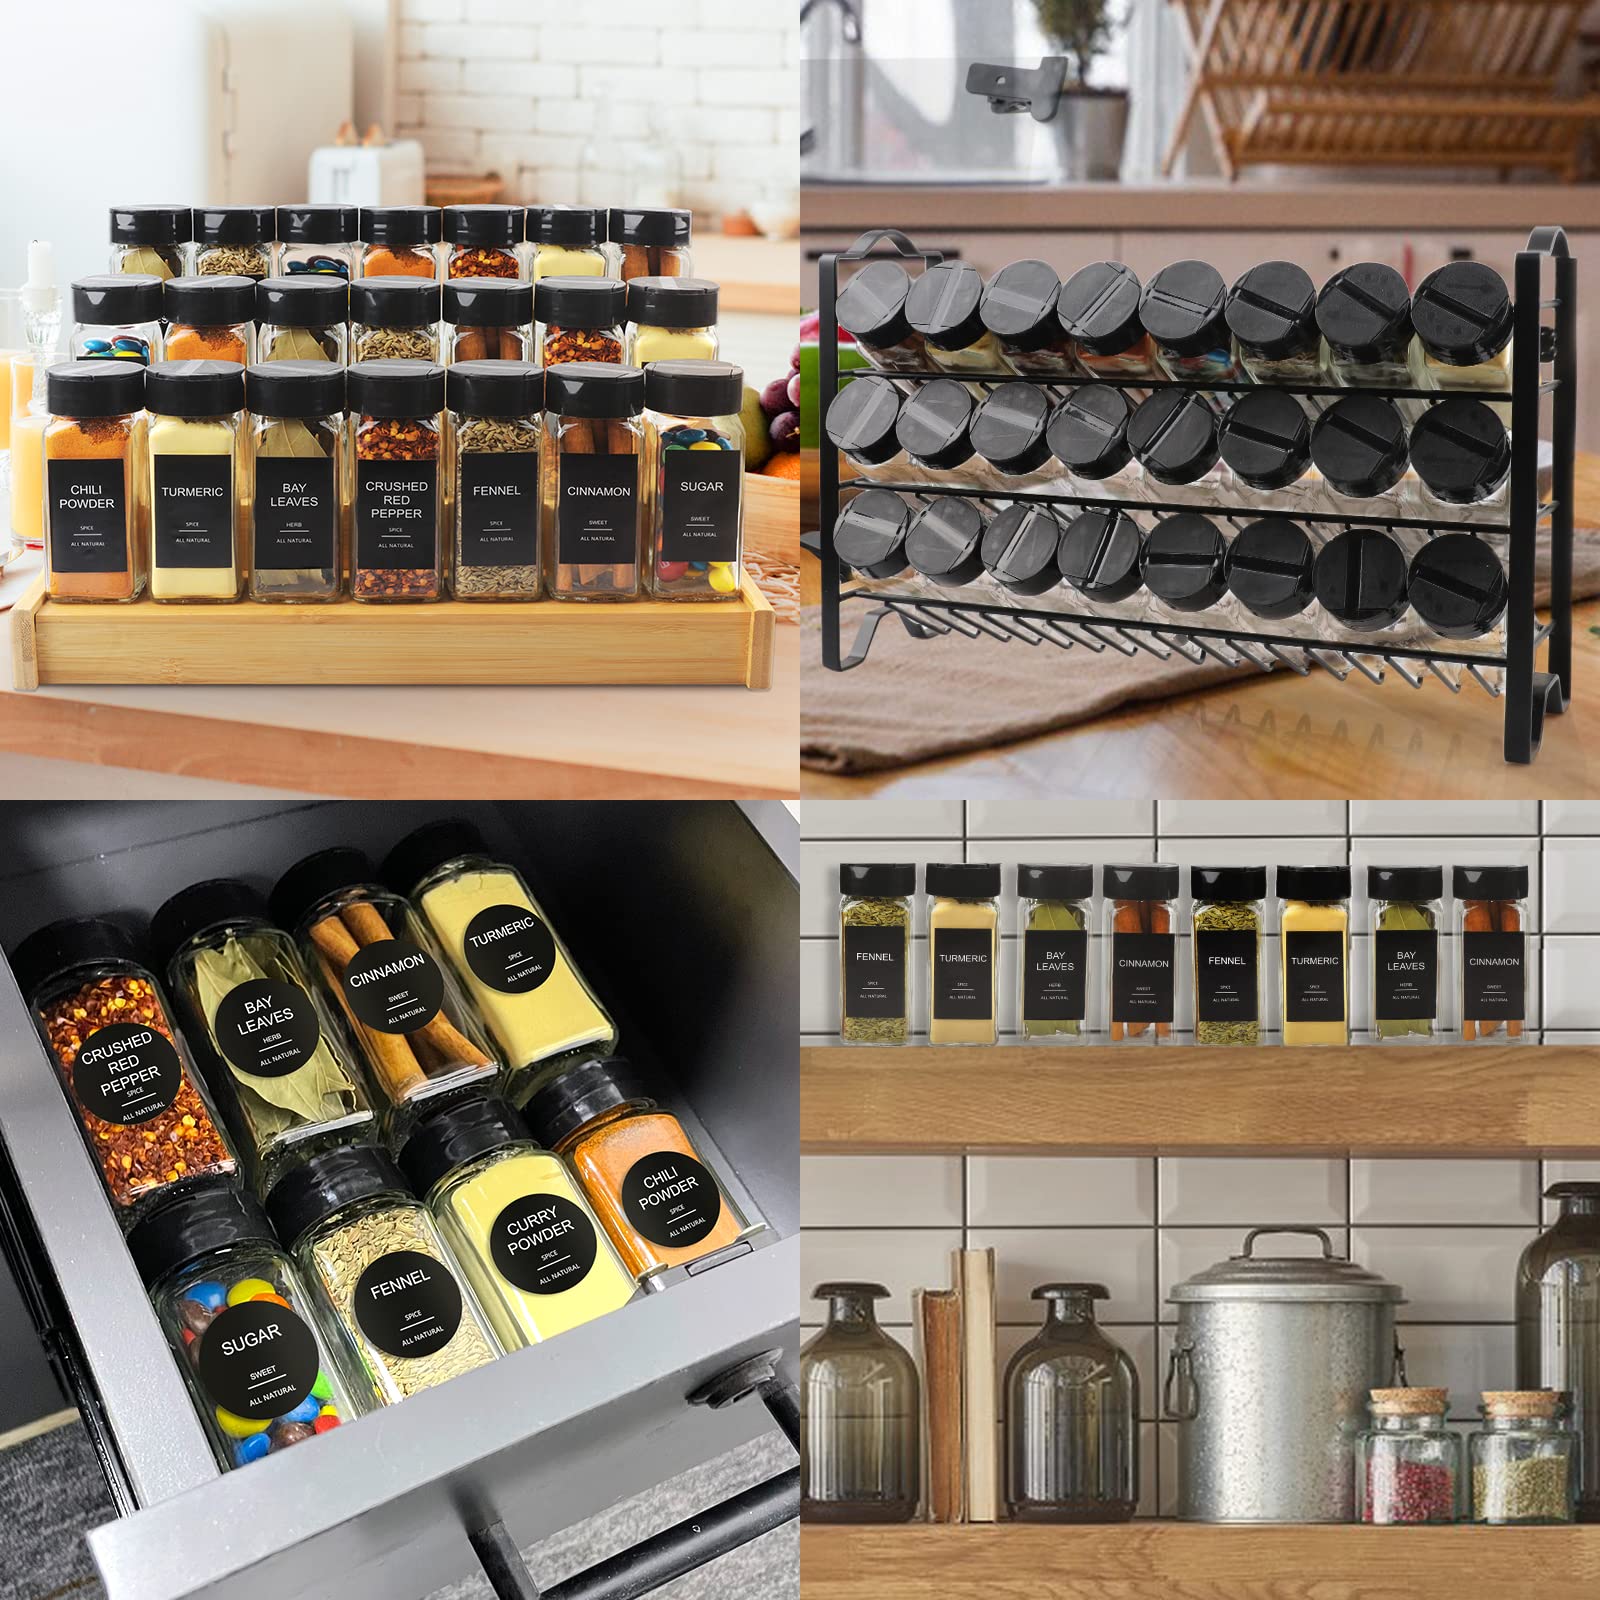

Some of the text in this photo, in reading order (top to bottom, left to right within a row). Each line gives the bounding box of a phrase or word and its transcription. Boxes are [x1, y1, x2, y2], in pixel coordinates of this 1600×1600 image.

[71, 485, 101, 495] CHILI
[162, 487, 223, 496] TURMERIC
[283, 484, 306, 492] BAY
[366, 482, 428, 491] CRUSHED
[474, 486, 520, 495] FENNEL
[568, 487, 630, 496] CINNAMON
[681, 482, 723, 491] SUGAR
[60, 499, 114, 508] POWDER
[271, 497, 318, 506] LEAVES
[384, 496, 410, 505] RED
[372, 509, 421, 518] PEPPER
[470, 917, 535, 948] TURMERIC
[508, 952, 523, 961] SPICE
[857, 953, 893, 961] FENNEL
[350, 954, 424, 988] CINNAMON
[507, 965, 542, 983] ALL NATURAL
[244, 996, 273, 1015] BAY
[388, 991, 409, 1003] SWEET
[237, 1007, 294, 1036] LEAVES
[388, 1006, 427, 1025] ALL NATURAL
[263, 1033, 281, 1044] HERB
[81, 1032, 153, 1066] CRUSHED
[260, 1048, 301, 1066] ALL NATURAL
[109, 1055, 140, 1074] RED
[100, 1066, 162, 1096] PEPPER
[127, 1087, 144, 1098] SPICE
[122, 1101, 165, 1122] ALL NATURAL
[643, 1166, 678, 1190] CHILI
[639, 1177, 699, 1211] POWDER
[670, 1205, 685, 1216] SPICE
[507, 1206, 558, 1237] CURRY
[669, 1217, 706, 1238] ALL NATURAL
[508, 1220, 575, 1256] POWDER
[541, 1250, 558, 1262] SPICE
[540, 1264, 580, 1286] ALL NATURAL
[371, 1269, 431, 1300] FENNEL
[405, 1310, 422, 1321] SPICE
[221, 1324, 282, 1356] SUGAR
[402, 1326, 444, 1347] ALL NATURAL
[250, 1365, 276, 1381] SWEET
[250, 1385, 297, 1407] ALL NATURAL
